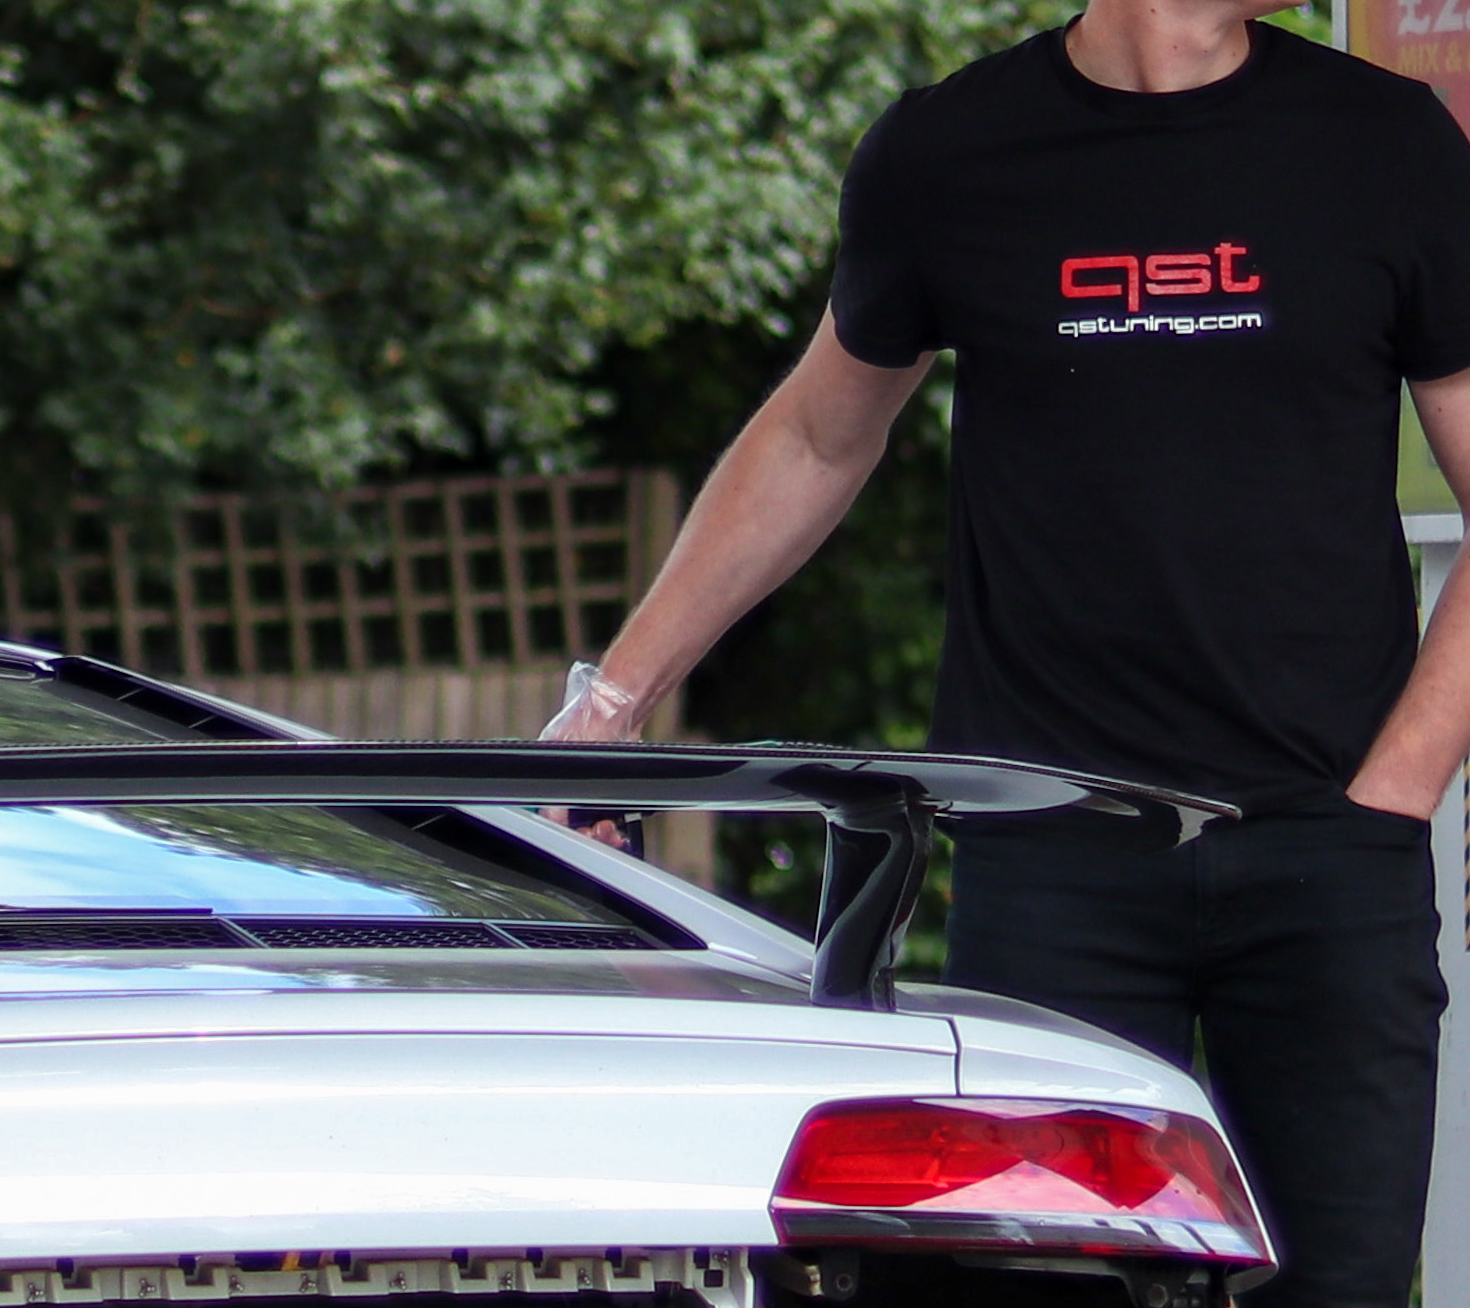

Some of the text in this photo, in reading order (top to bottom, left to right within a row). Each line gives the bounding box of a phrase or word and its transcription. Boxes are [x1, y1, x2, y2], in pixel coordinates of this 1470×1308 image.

[1398, 43, 1440, 75] MIX
[1445, 41, 1462, 72] &
[1058, 312, 1262, 338] qstuning.com
